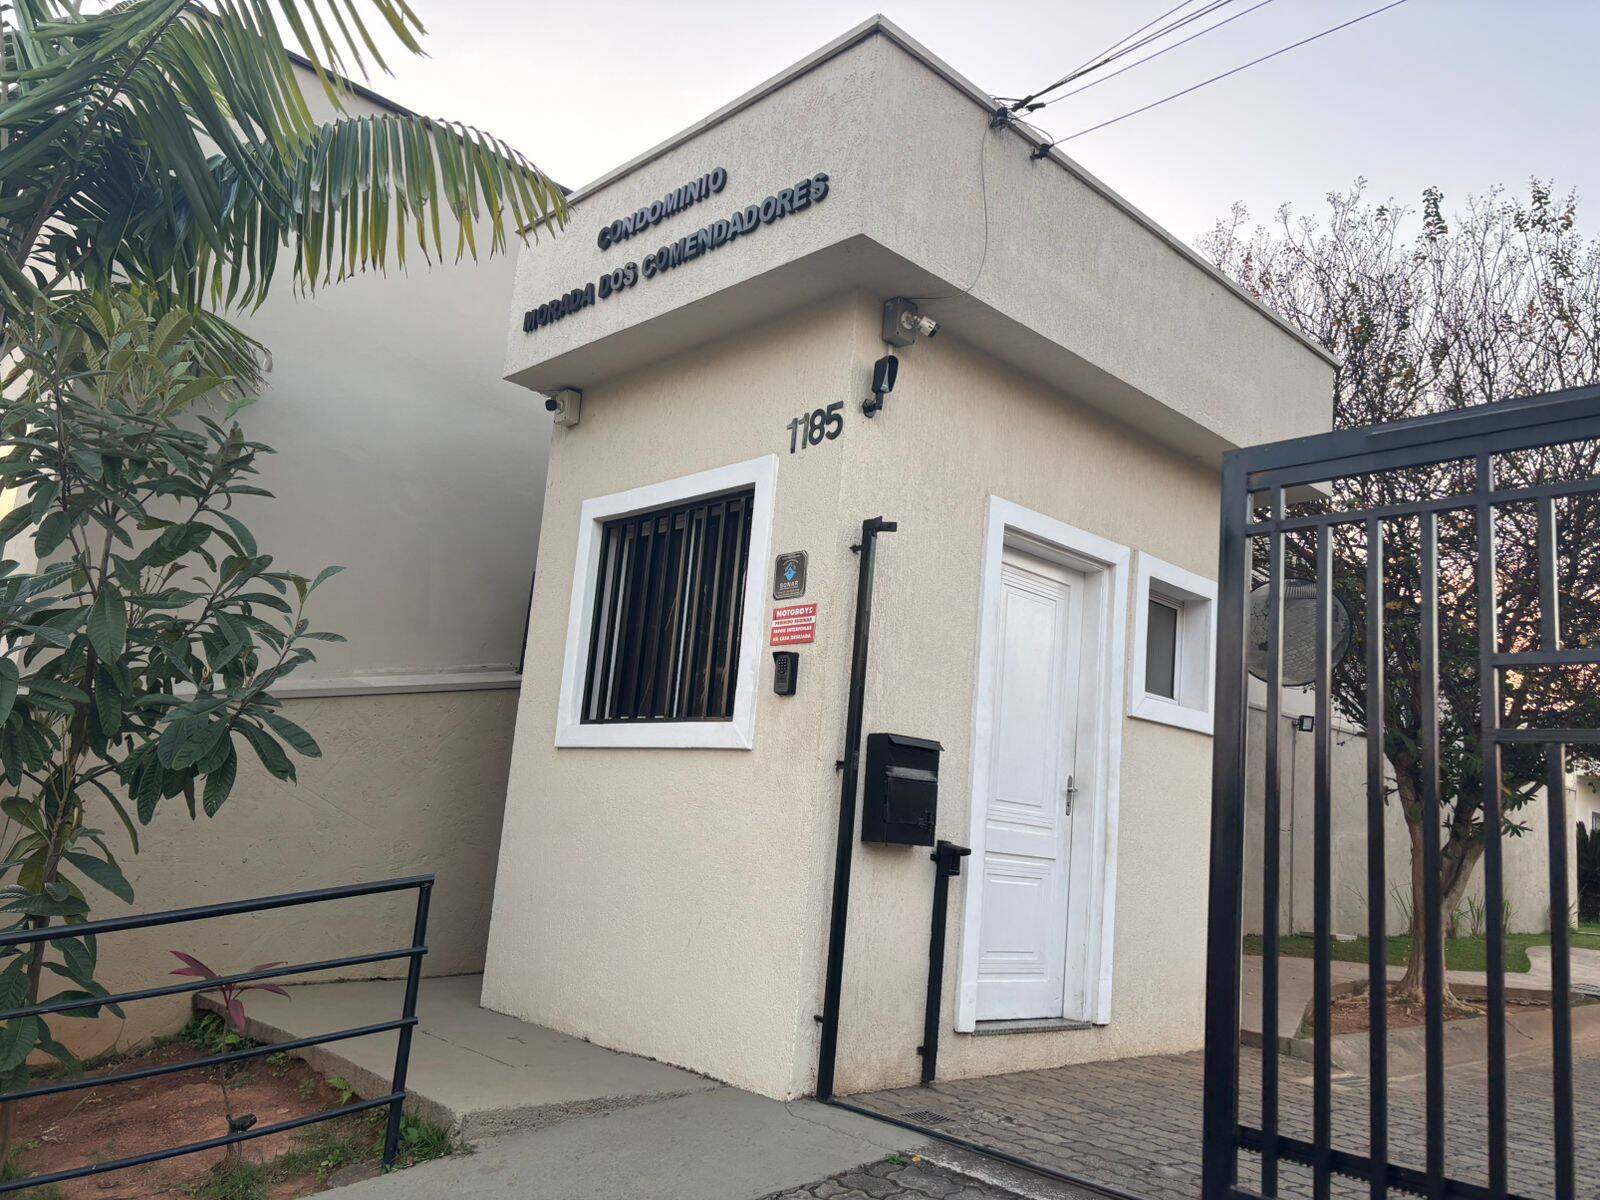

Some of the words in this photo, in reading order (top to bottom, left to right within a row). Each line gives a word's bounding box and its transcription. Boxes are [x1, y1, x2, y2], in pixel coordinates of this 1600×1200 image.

[597, 166, 727, 250] CONDOMINIO
[523, 282, 595, 333] MORADA
[598, 261, 638, 299] DOS
[641, 172, 830, 278] COMENDADORES
[787, 400, 844, 454] 1185
[776, 607, 813, 618] MOTOBOYS
